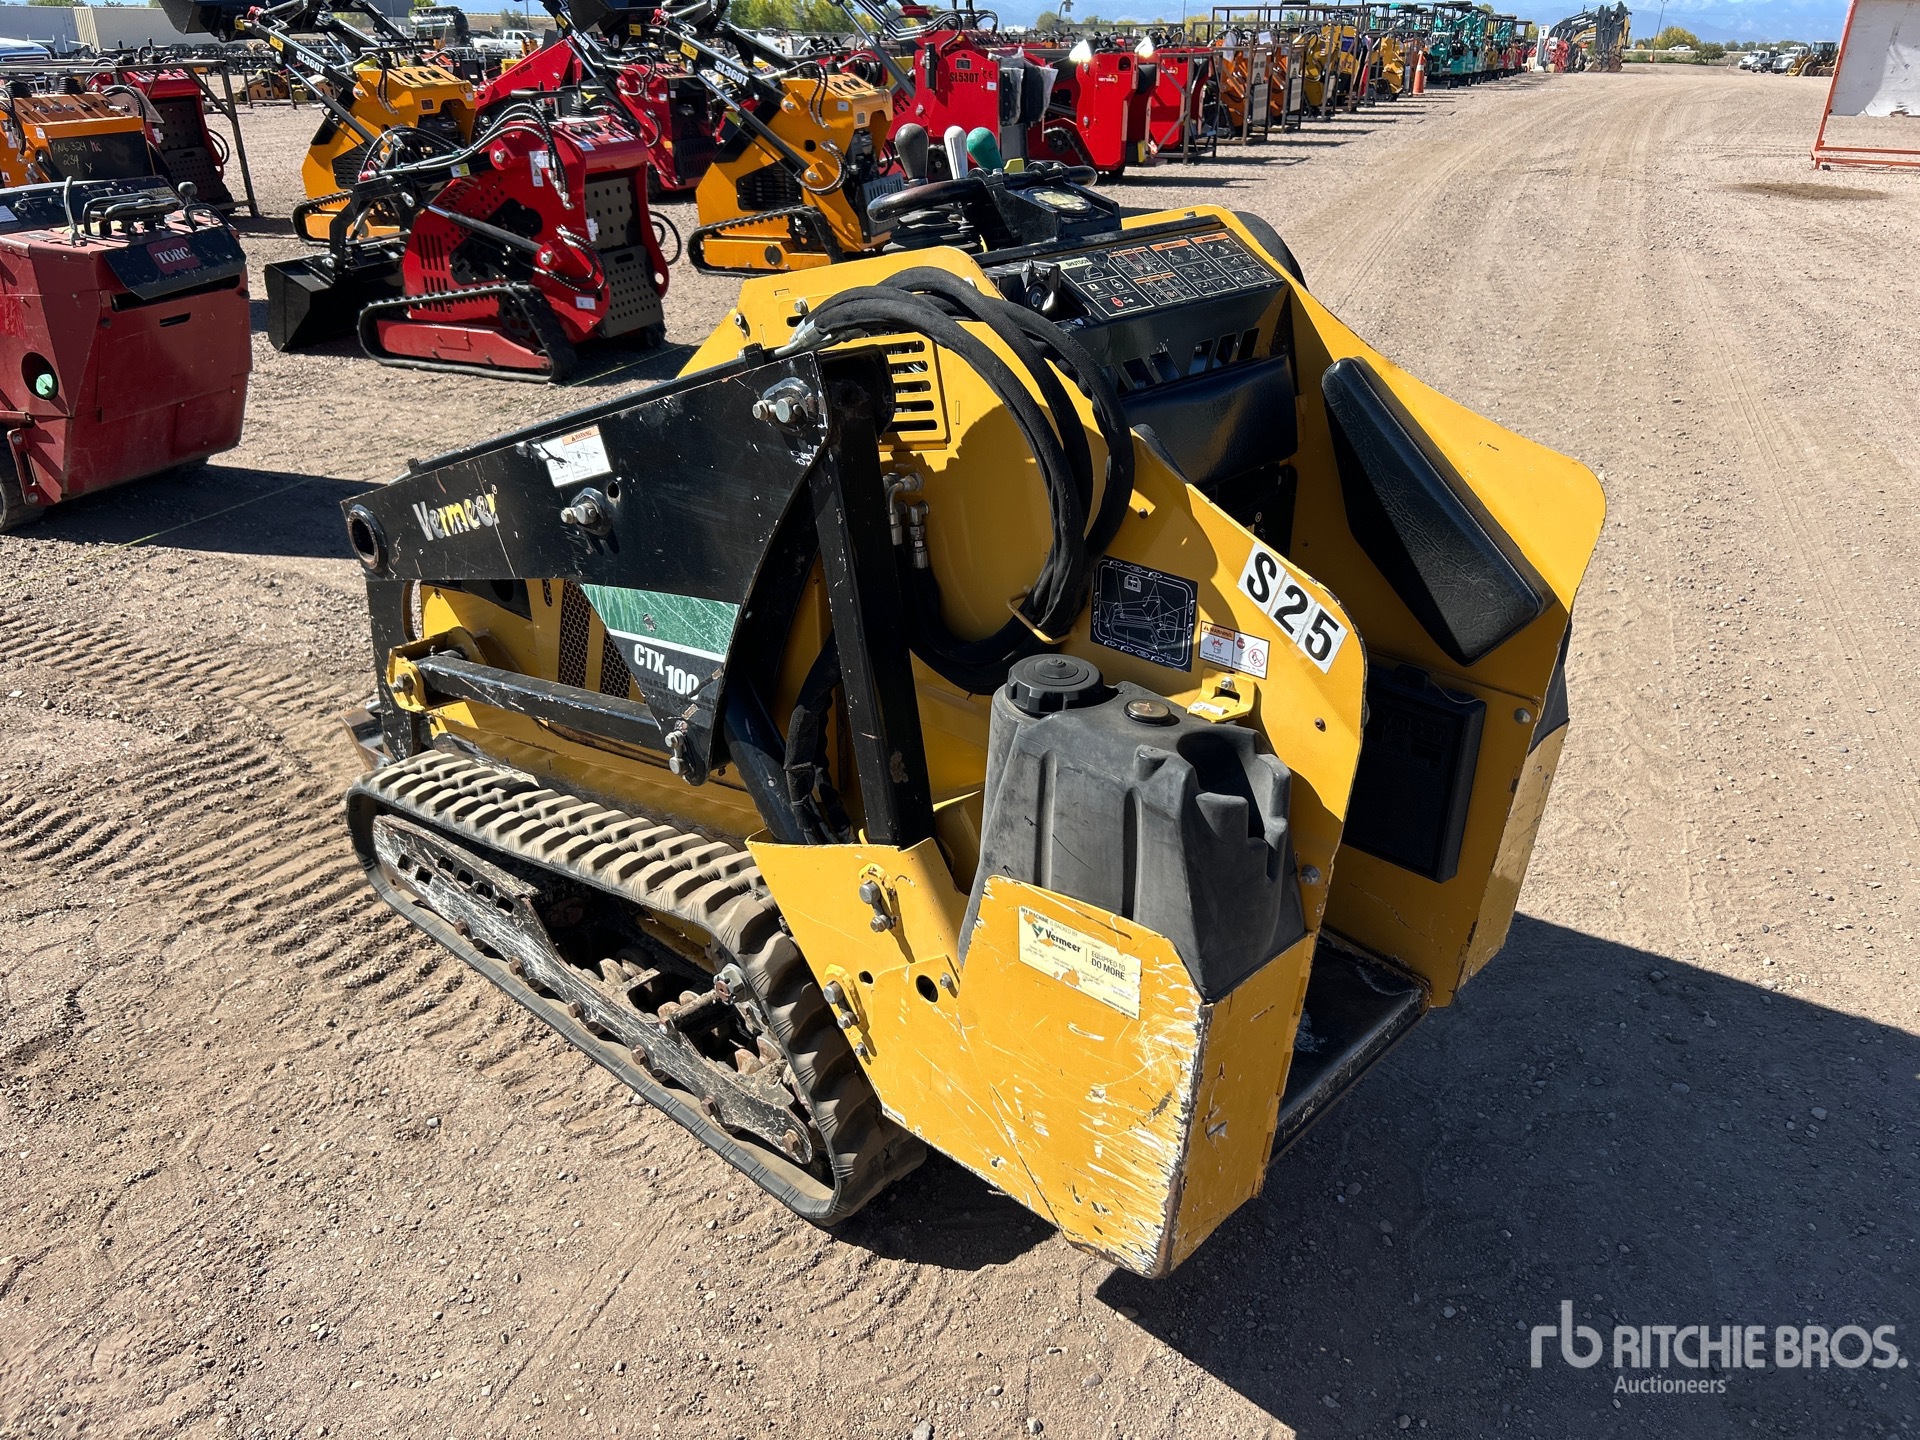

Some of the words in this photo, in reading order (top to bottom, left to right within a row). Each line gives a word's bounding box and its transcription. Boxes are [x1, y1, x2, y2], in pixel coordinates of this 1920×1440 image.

[296, 50, 325, 75] SL360T
[714, 60, 750, 87] SL360T
[949, 72, 979, 83] SL530T
[1247, 552, 1340, 662] S25
[1045, 929, 1081, 953] Vermeer
[1091, 950, 1118, 968] EQUIPPED
[1118, 961, 1126, 972] TO
[1091, 958, 1102, 970] DO
